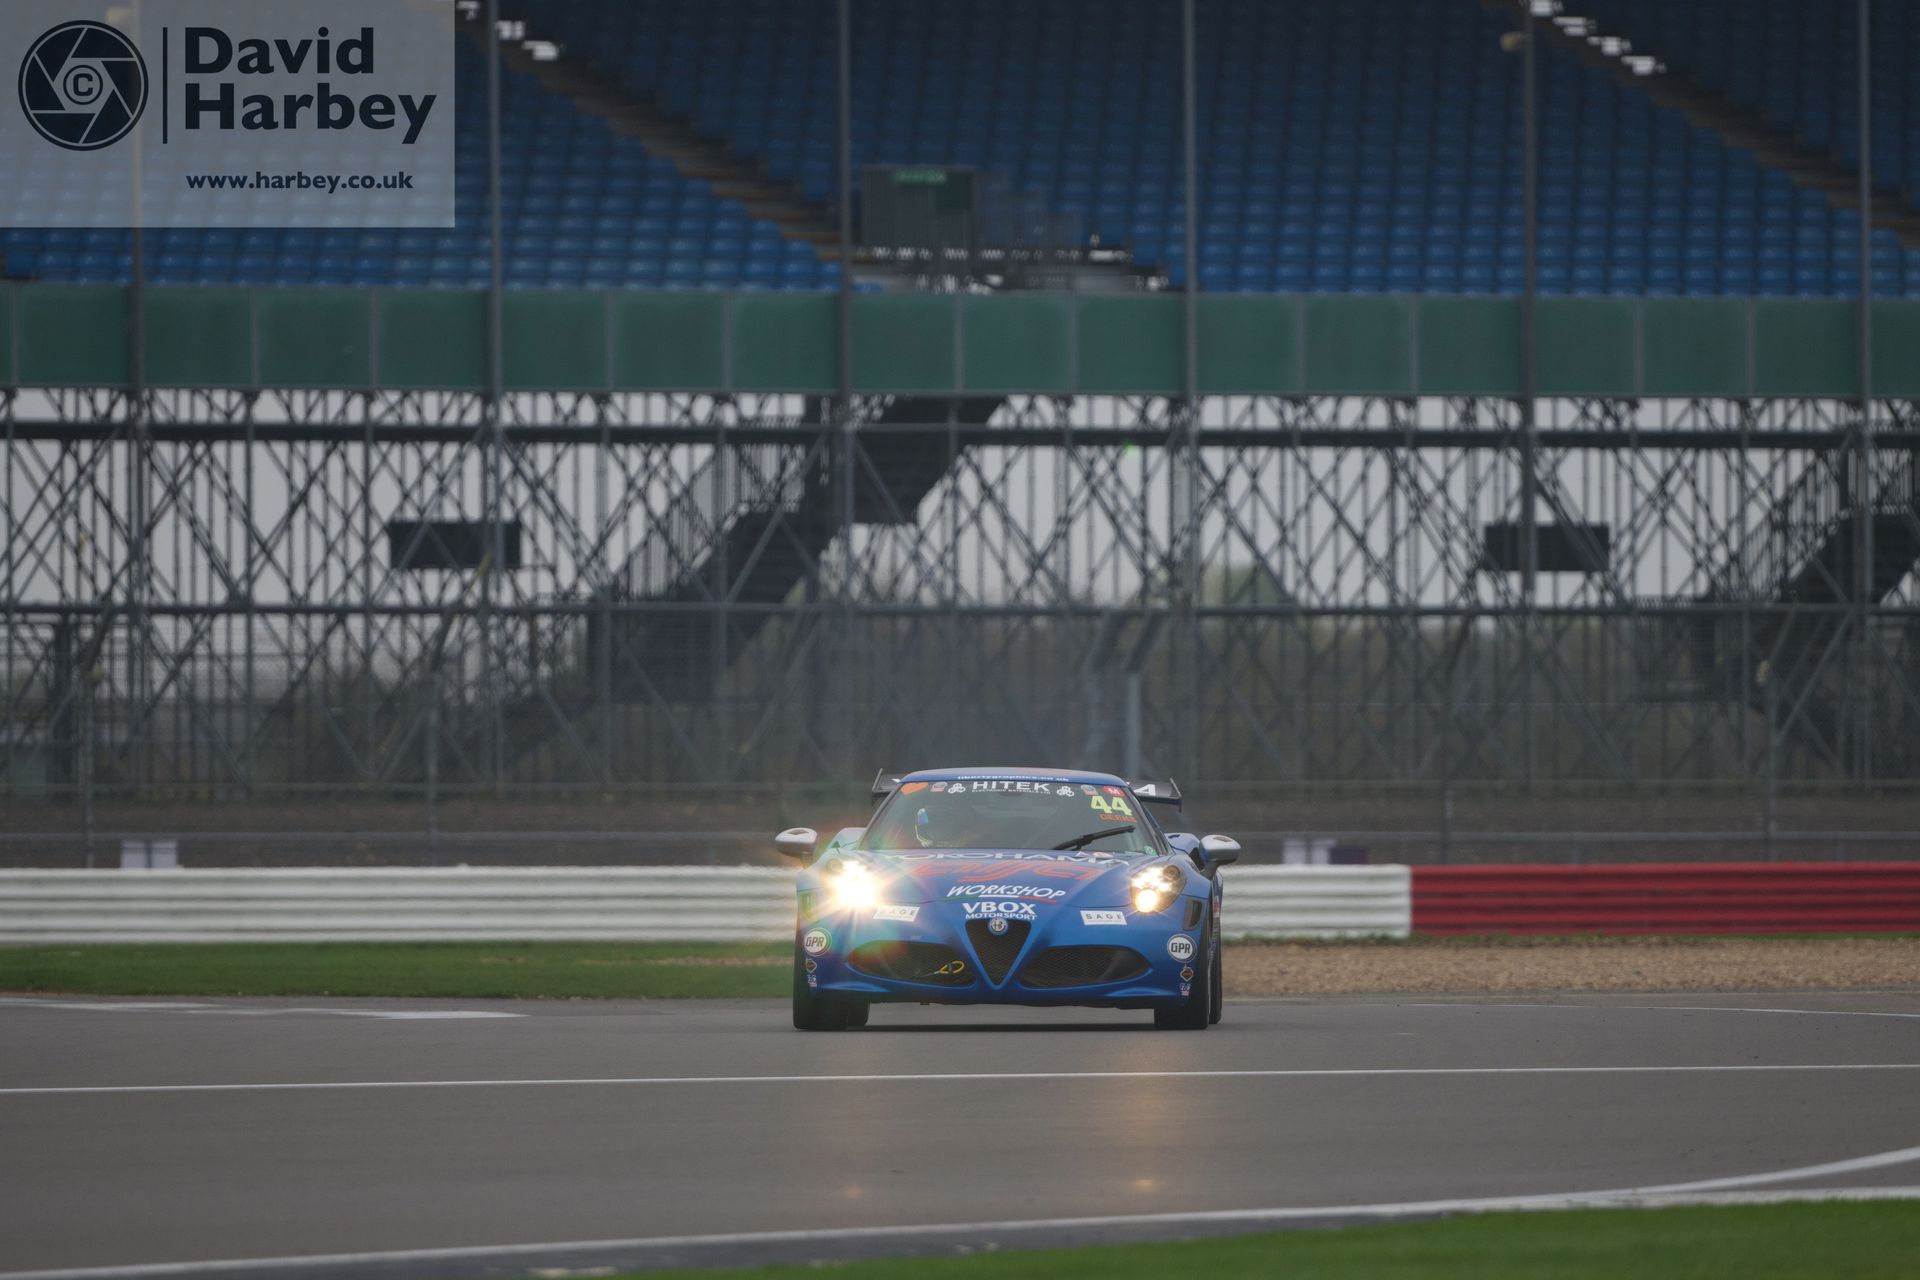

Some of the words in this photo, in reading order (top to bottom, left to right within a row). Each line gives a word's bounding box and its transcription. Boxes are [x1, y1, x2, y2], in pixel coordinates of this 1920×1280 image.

[972, 781, 1051, 792] HITEK
[1090, 795, 1133, 816] 44
[885, 852, 1130, 866] YOKOHAMA
[946, 884, 1067, 899] WORKSHOP
[962, 901, 1037, 915] VBOX
[965, 911, 1038, 920] MOTORSPORT
[805, 936, 825, 948] GPR
[1170, 942, 1191, 954] GPR
